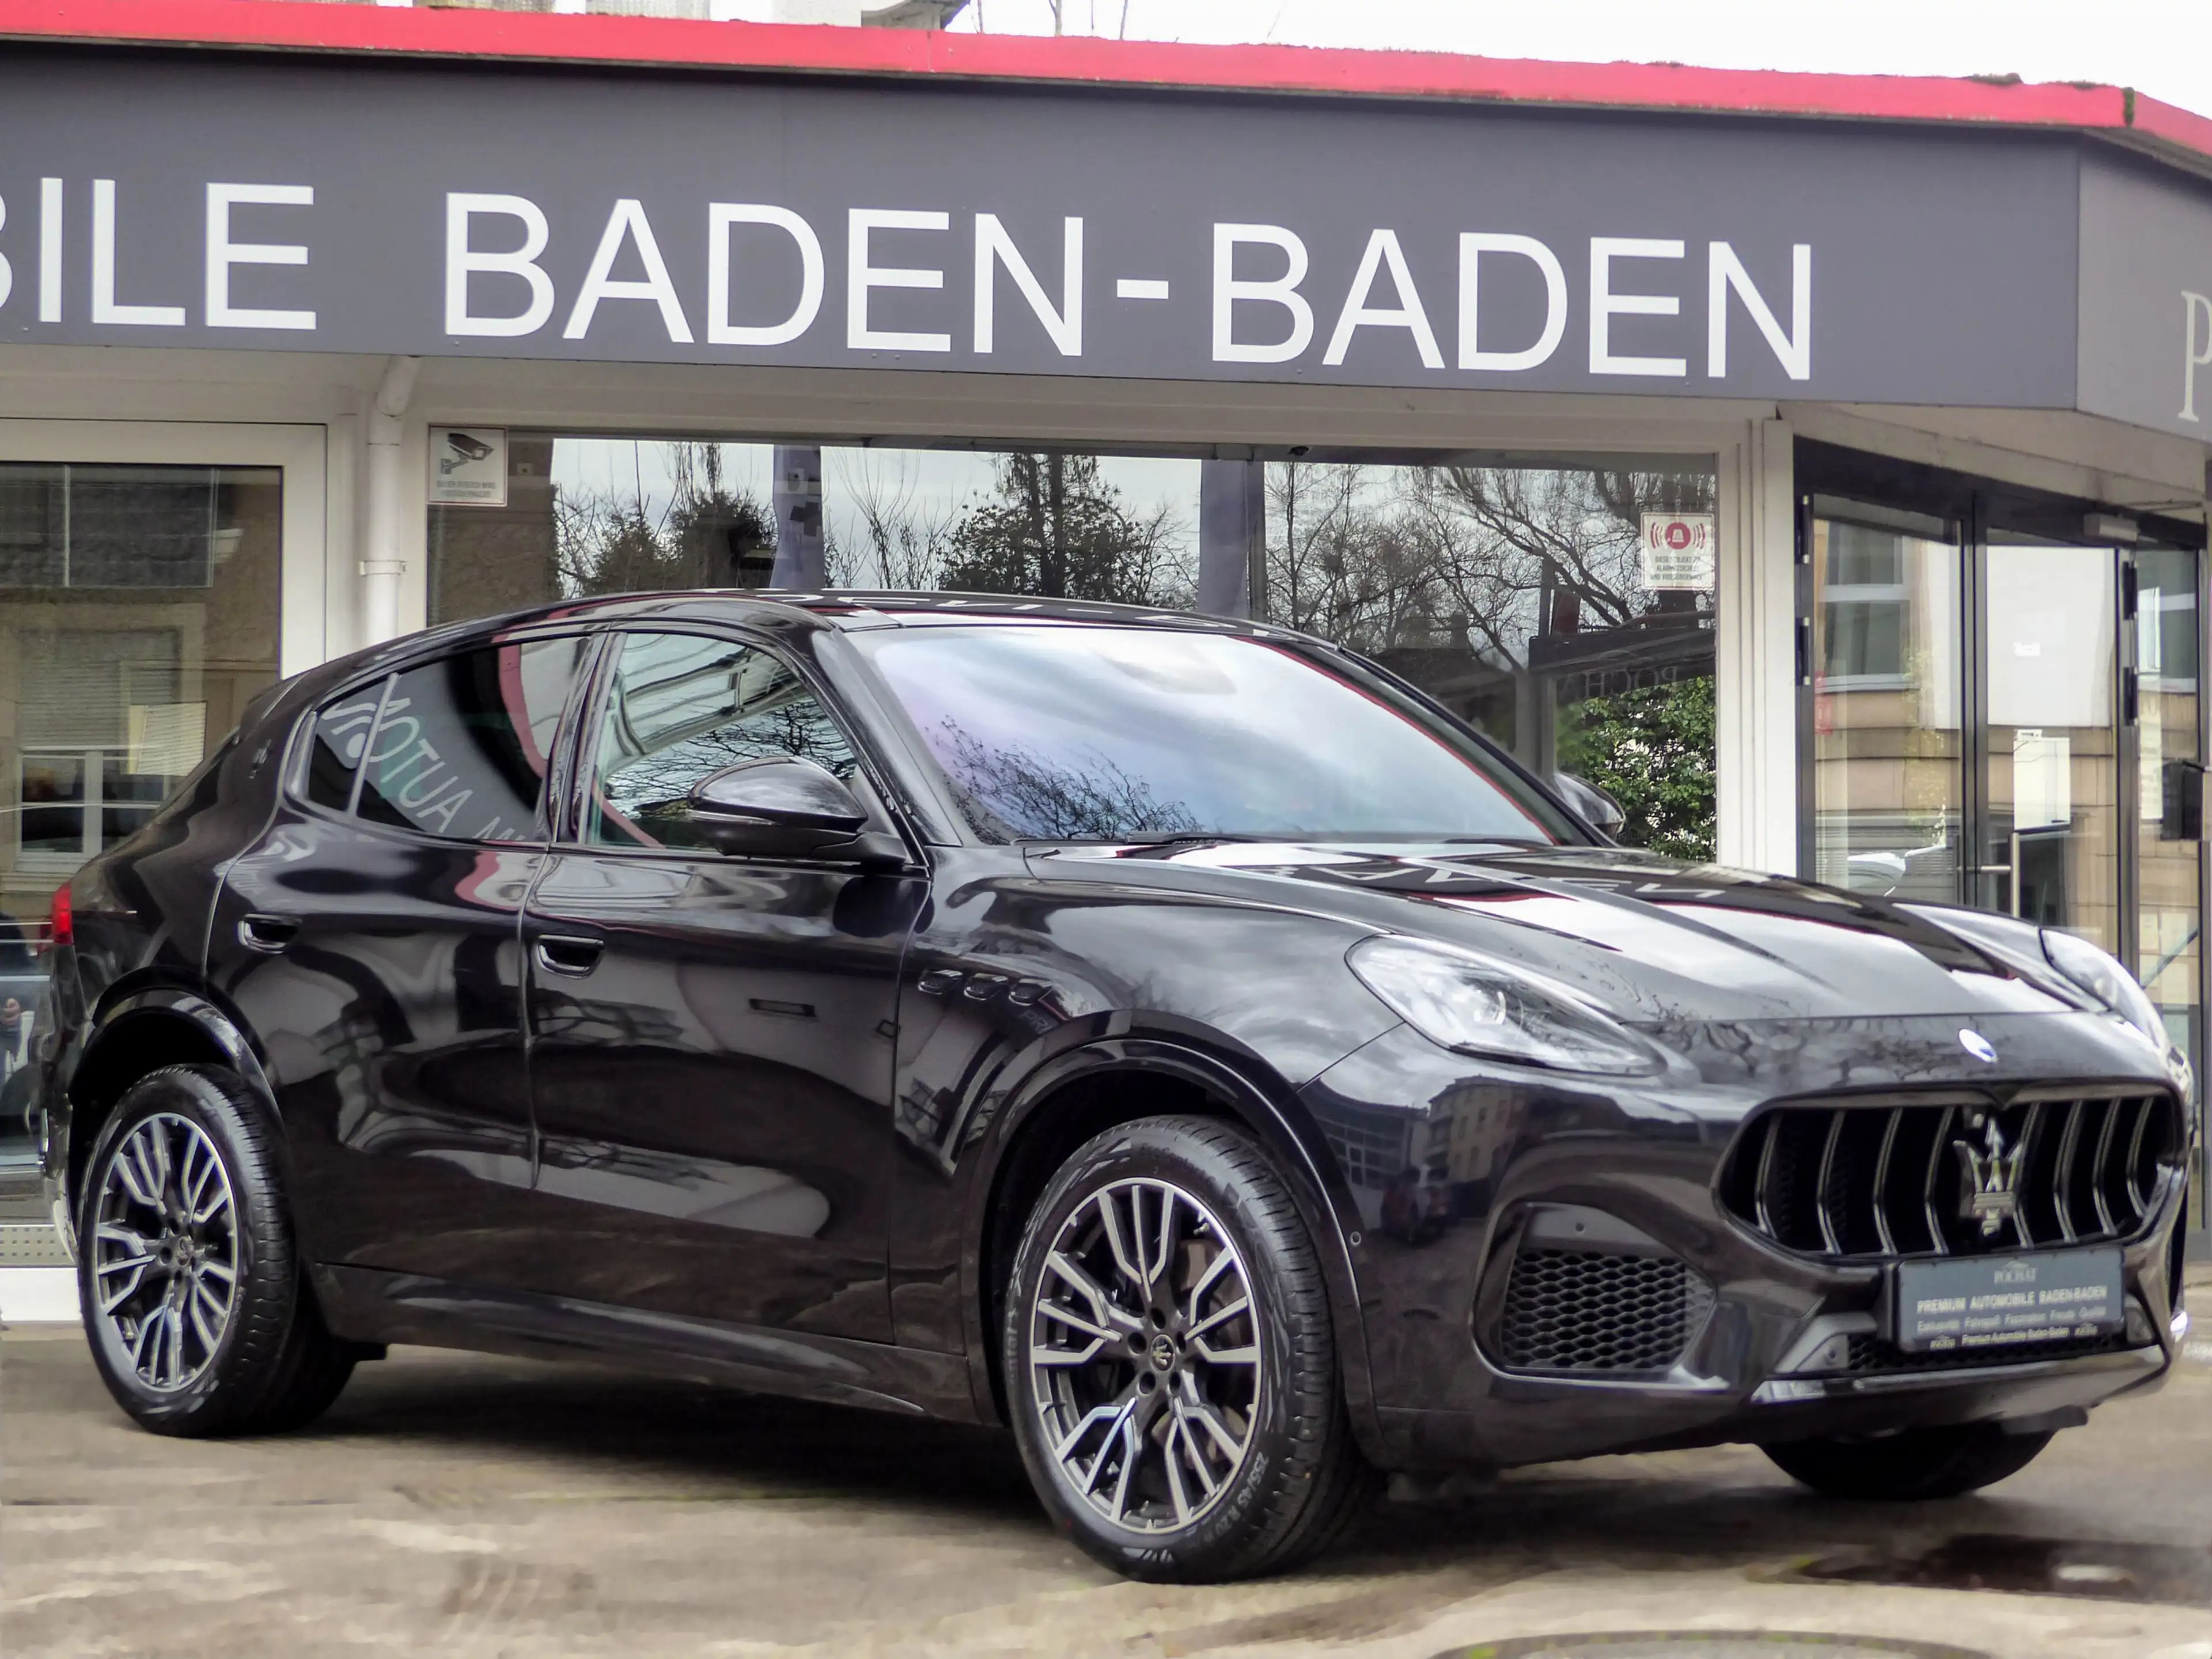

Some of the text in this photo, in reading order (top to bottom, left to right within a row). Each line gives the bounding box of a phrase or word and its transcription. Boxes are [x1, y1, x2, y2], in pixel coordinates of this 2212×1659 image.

[0, 176, 1812, 381] ILE BADEN-BADEN
[1916, 1297, 1966, 1314] PREMIUM
[1969, 1290, 2035, 1310] AUTOMOBILE
